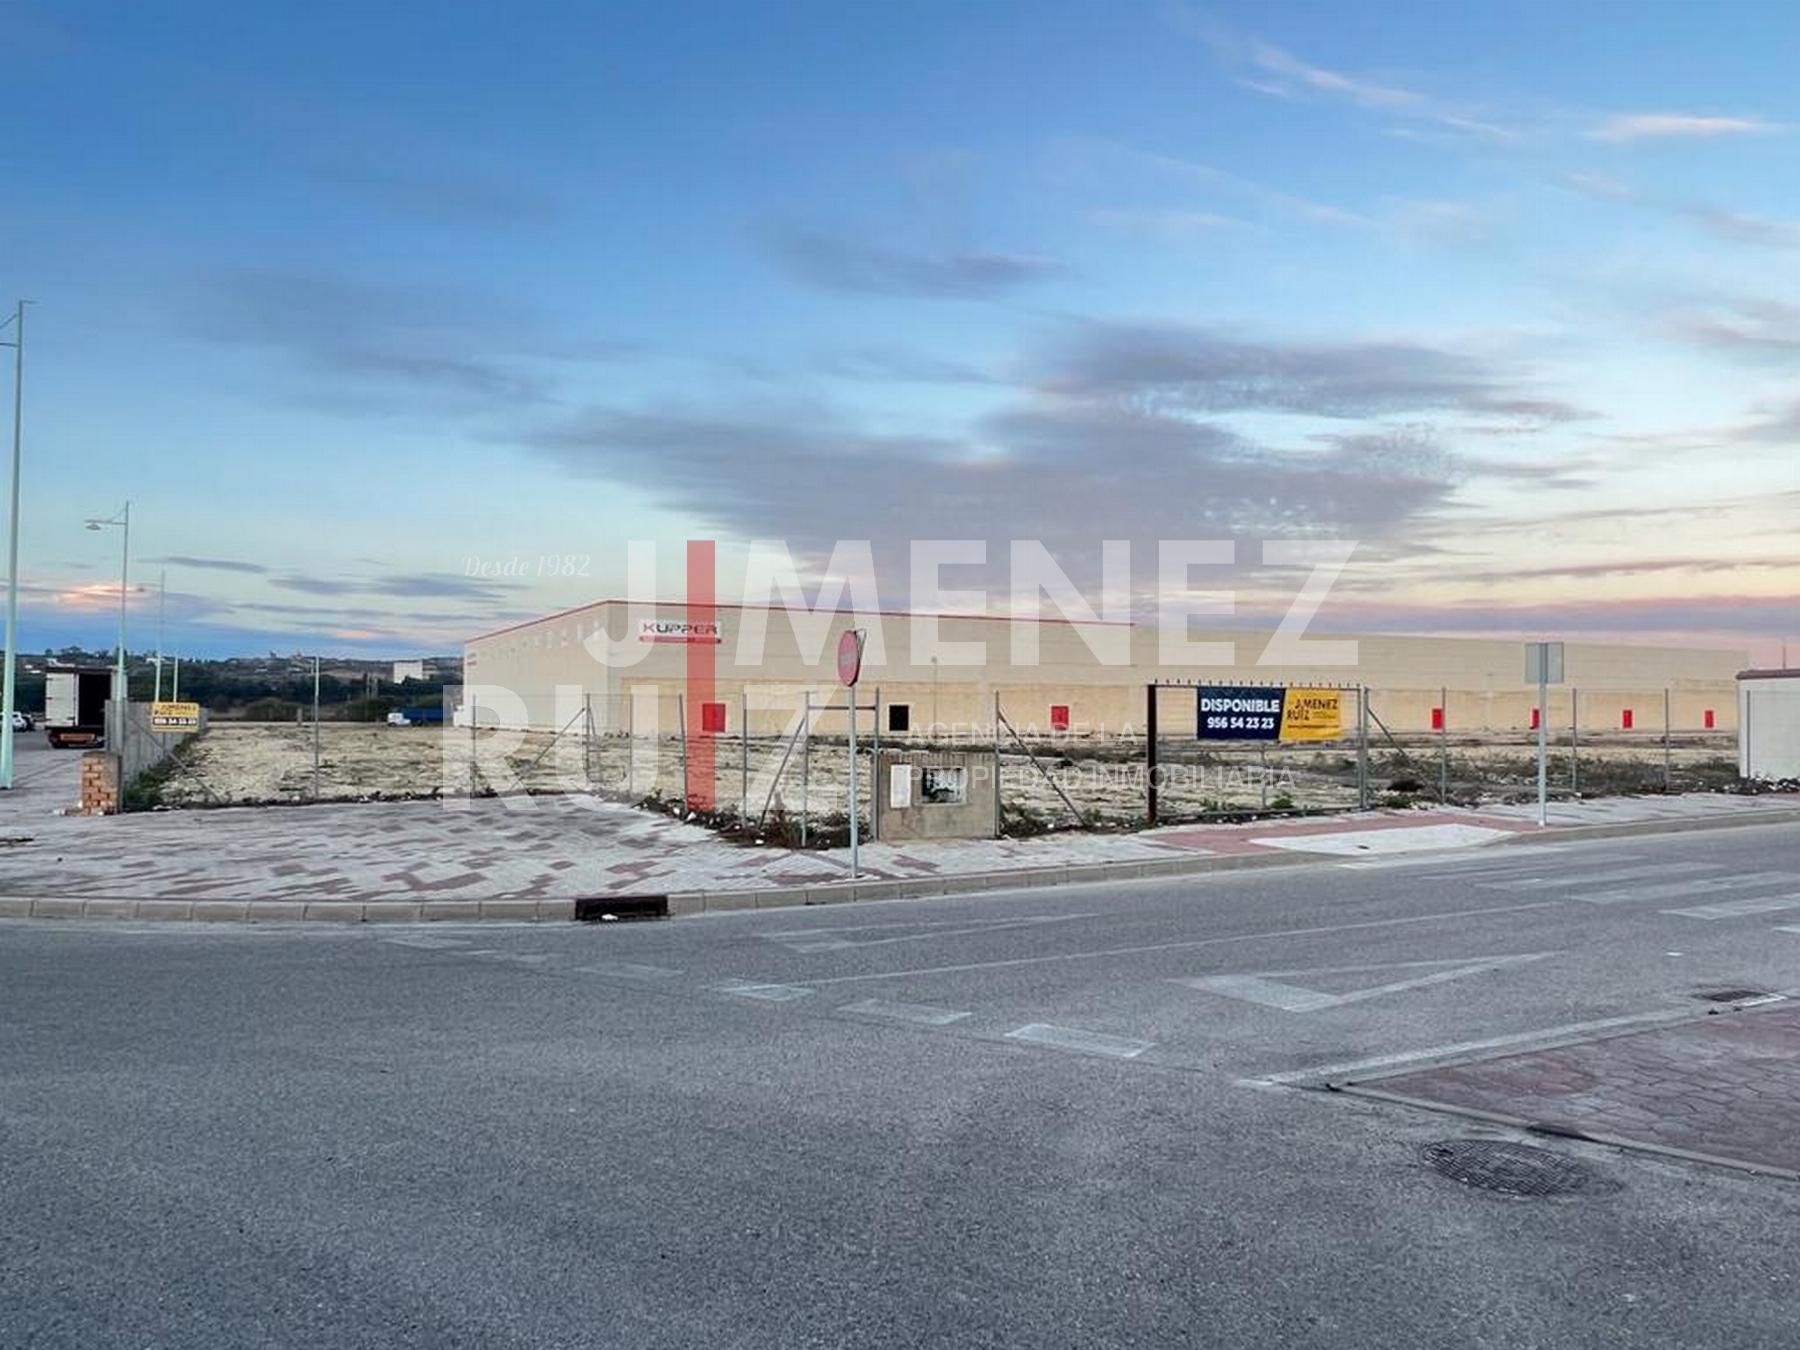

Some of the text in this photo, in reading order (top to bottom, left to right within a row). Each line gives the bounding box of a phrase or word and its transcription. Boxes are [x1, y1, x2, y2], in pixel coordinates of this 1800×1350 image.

[643, 623, 718, 634] KUPPER
[1201, 699, 1280, 712] DISPONIBLE
[1207, 717, 1274, 729] 956 54 23 23
